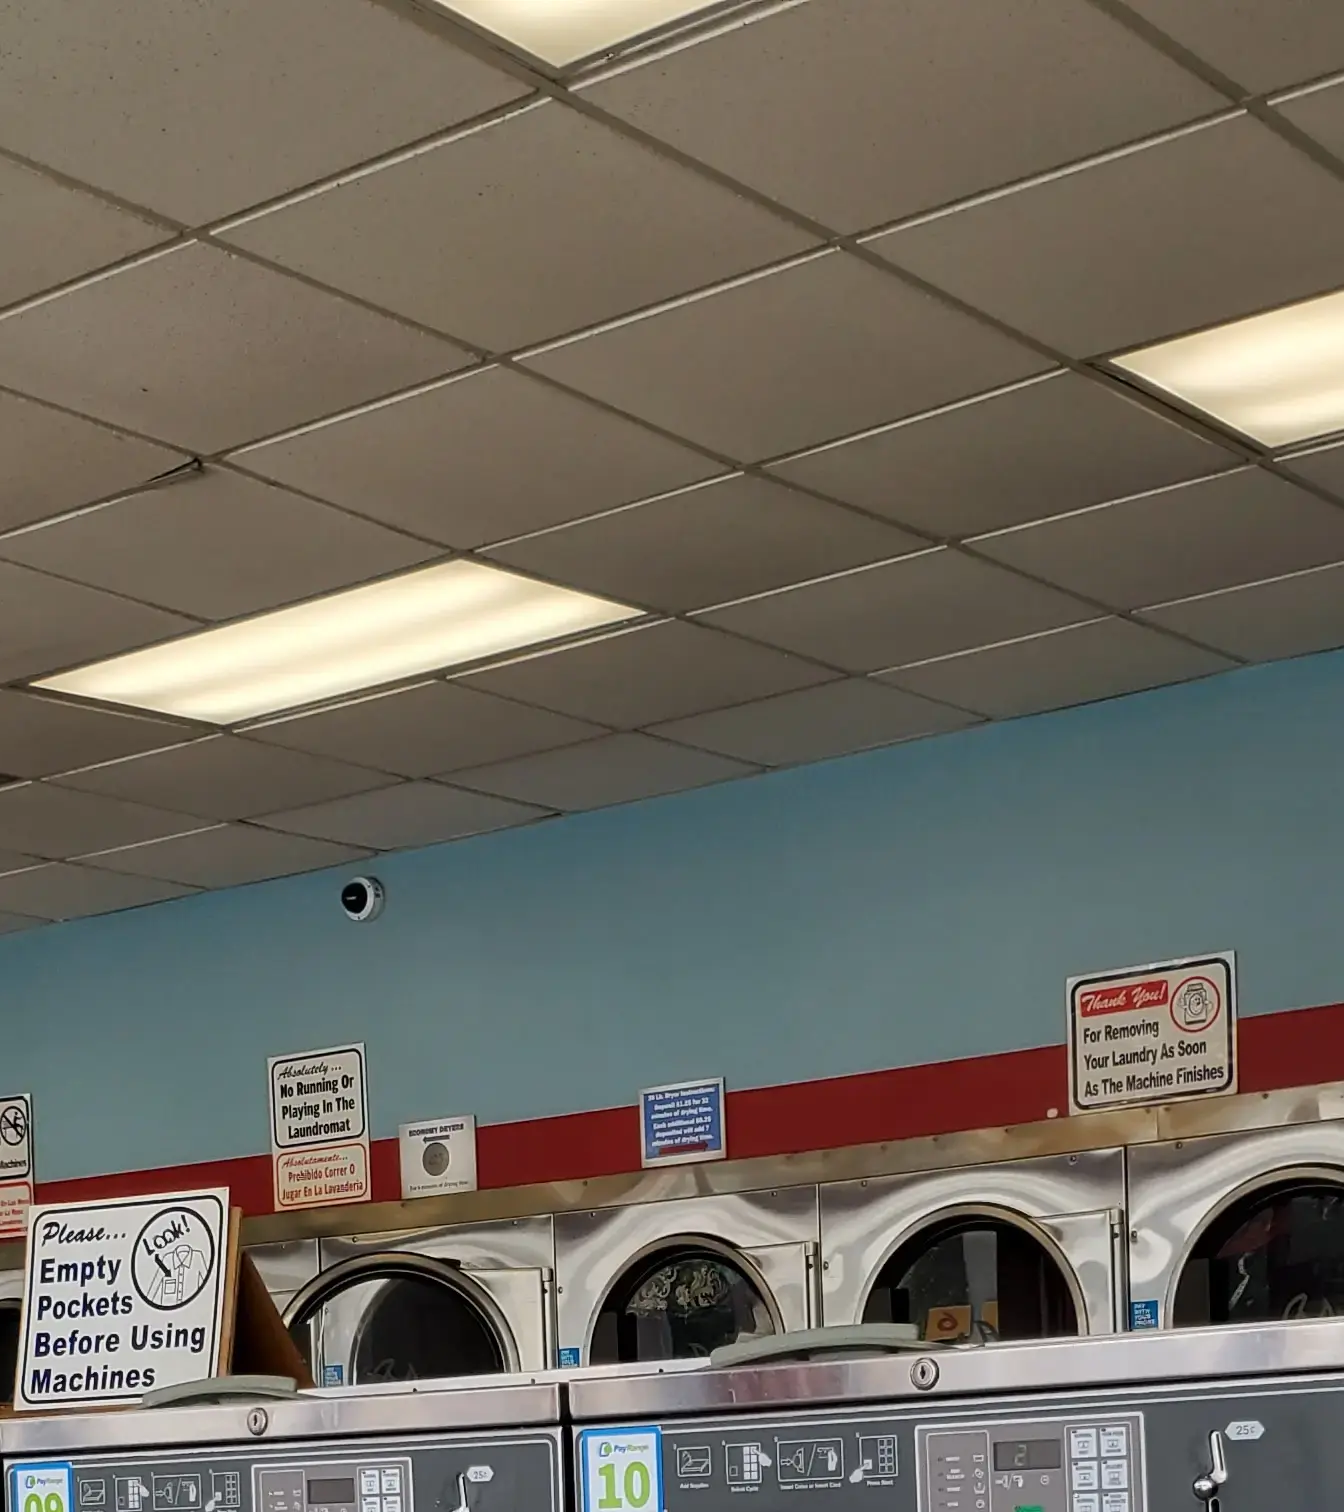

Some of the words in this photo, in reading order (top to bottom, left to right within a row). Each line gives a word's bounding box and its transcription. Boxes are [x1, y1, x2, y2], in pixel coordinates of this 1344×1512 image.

[1081, 991, 1127, 1012] Thank
[1131, 983, 1164, 1008] You!
[1084, 1027, 1101, 1044] For
[1104, 1019, 1159, 1041] Removing
[1084, 1054, 1109, 1070] Your
[1112, 1046, 1158, 1066] Laundry
[1160, 1043, 1175, 1060] As
[1178, 1040, 1207, 1056] Soon
[277, 1062, 329, 1080] Absolutely
[1084, 1081, 1099, 1097] As
[1102, 1077, 1123, 1095] The
[1126, 1071, 1173, 1091] Machine
[1176, 1066, 1224, 1084] Finishes
[280, 1084, 293, 1098] No
[296, 1077, 339, 1096] Running
[341, 1075, 354, 1088] Or
[282, 1104, 320, 1120] Playing
[322, 1100, 333, 1113] In
[335, 1097, 355, 1111] The
[288, 1118, 350, 1139] Laundromat
[288, 1168, 323, 1183] Prohibido
[325, 1165, 347, 1178] Correr
[282, 1187, 301, 1201] Jugar
[304, 1186, 313, 1196] En
[315, 1184, 323, 1195] La
[42, 1220, 127, 1249] Please...
[40, 1255, 121, 1287] Empty
[37, 1290, 133, 1321] Pockets
[34, 1330, 120, 1359] Before
[131, 1323, 206, 1354] Using
[31, 1366, 155, 1396] Machines
[614, 1445, 649, 1453] PayRange
[598, 1461, 651, 1509] 10
